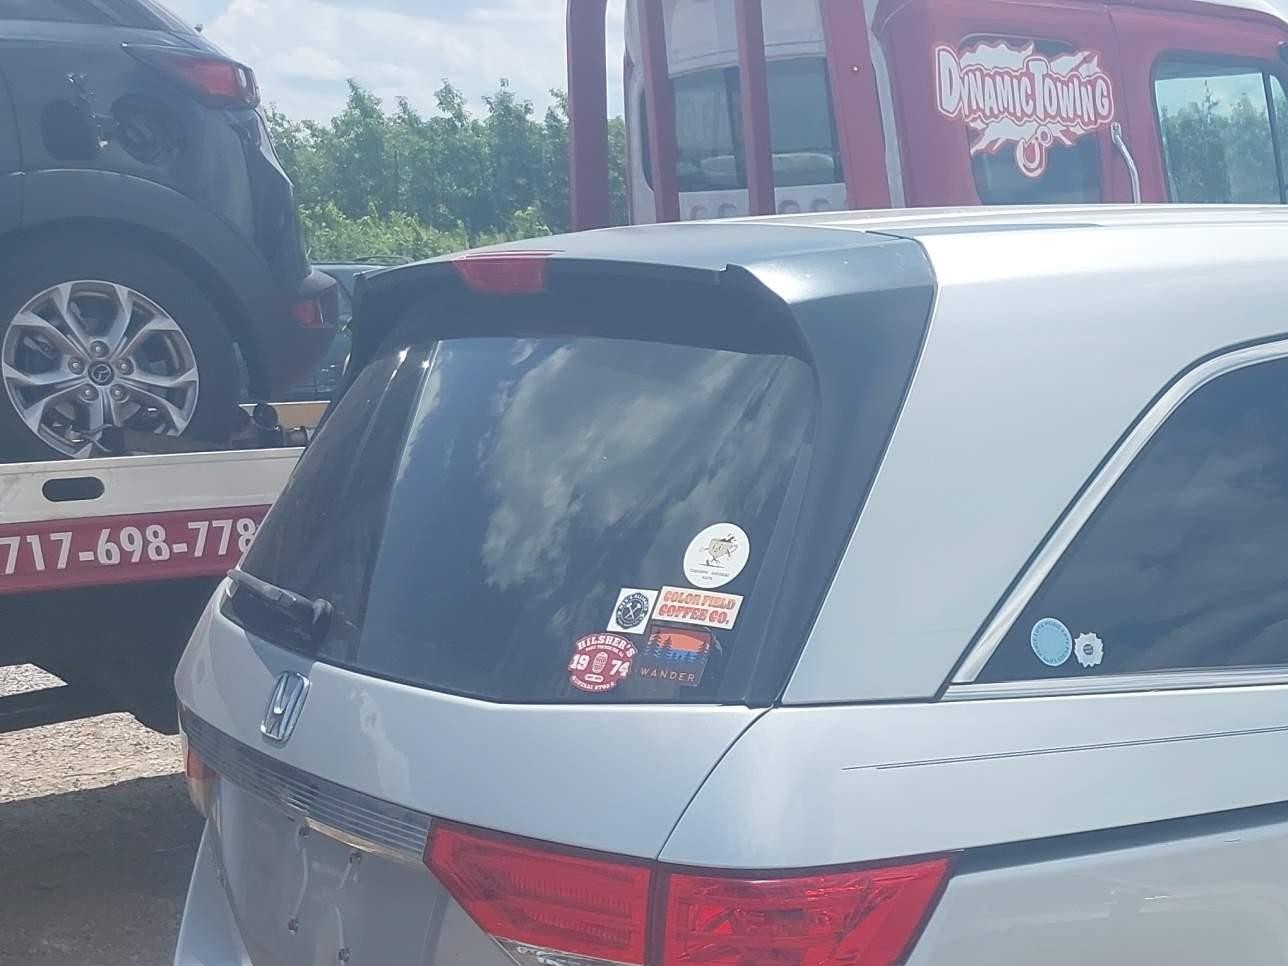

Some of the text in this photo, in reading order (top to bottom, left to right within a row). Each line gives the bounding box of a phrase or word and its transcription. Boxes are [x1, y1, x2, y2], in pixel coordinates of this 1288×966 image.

[0, 517, 259, 574] 717-698-778
[663, 590, 736, 610] COLOR FIELD
[659, 603, 708, 621] COFFEE
[708, 610, 730, 625] CO.
[577, 635, 635, 657] HILSHER'S
[569, 653, 590, 671] 19
[609, 659, 630, 677] 74
[640, 667, 695, 682] WANDER
